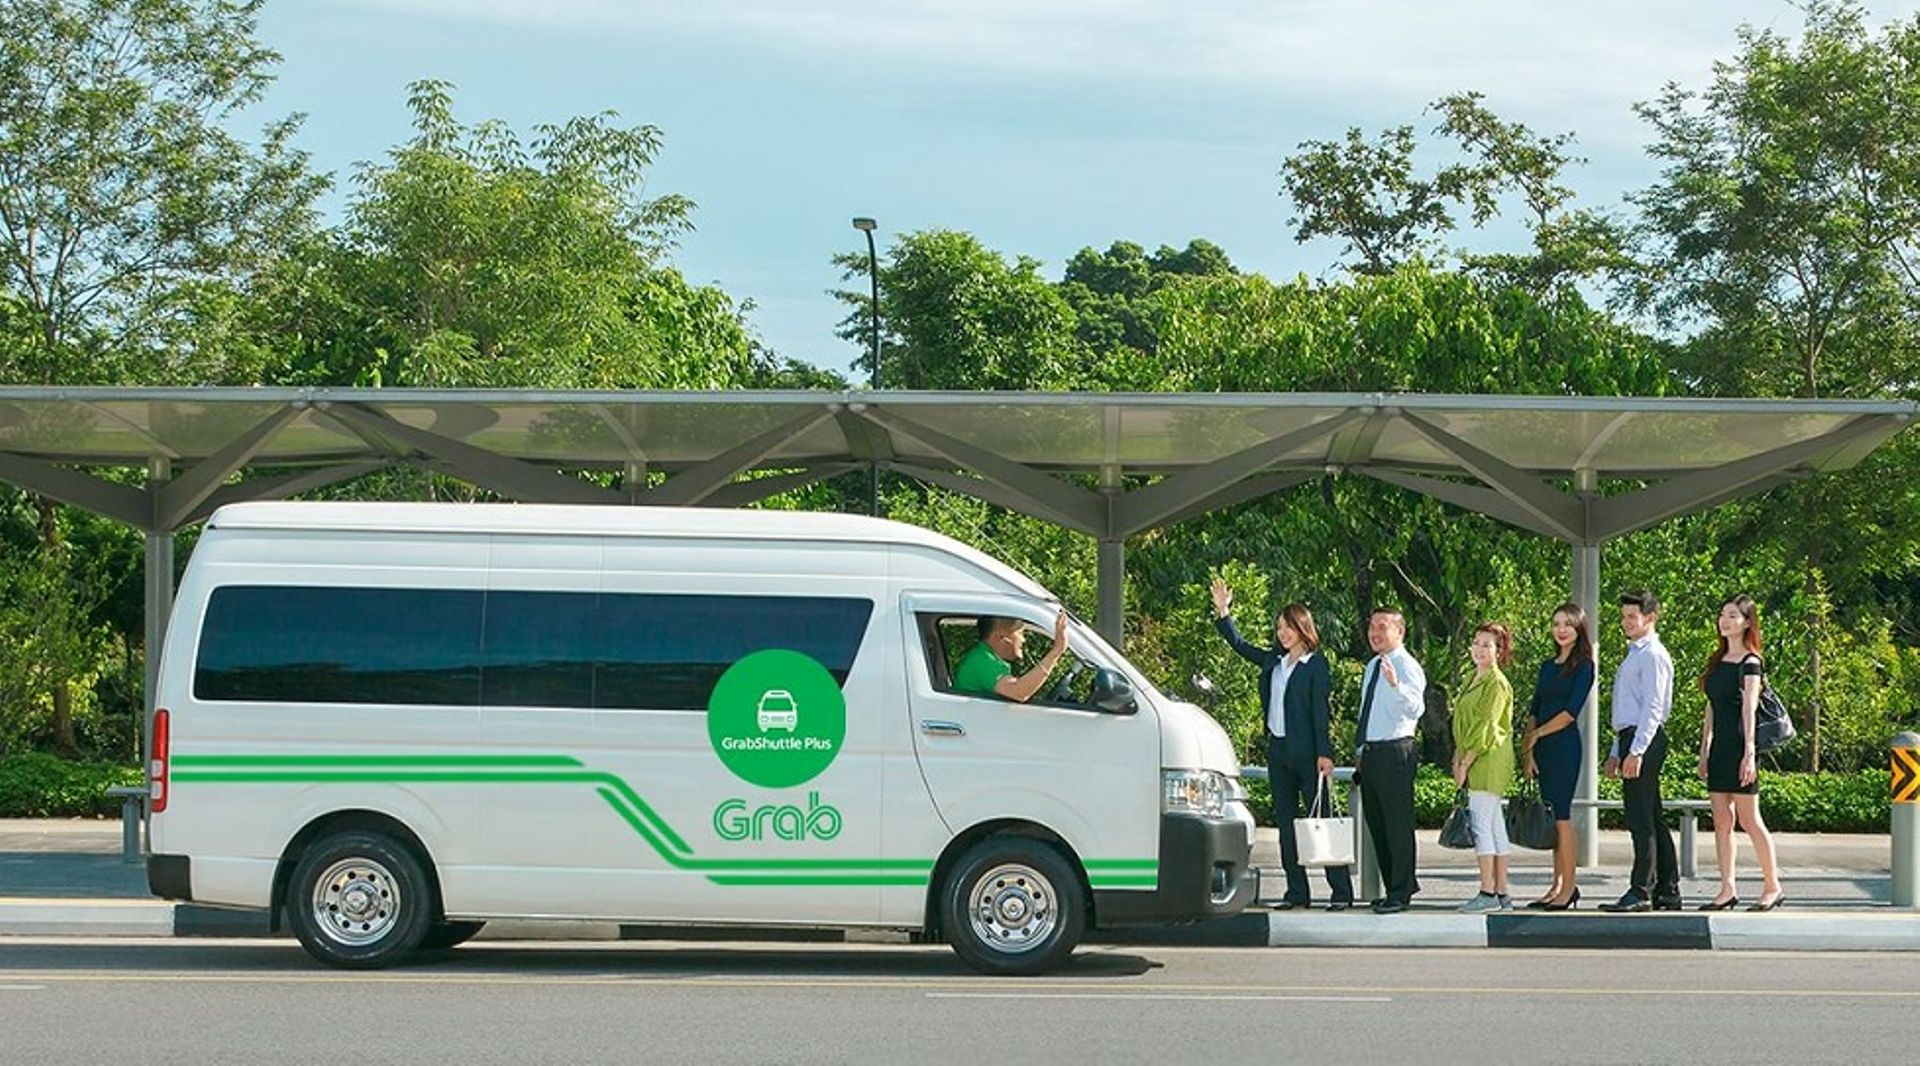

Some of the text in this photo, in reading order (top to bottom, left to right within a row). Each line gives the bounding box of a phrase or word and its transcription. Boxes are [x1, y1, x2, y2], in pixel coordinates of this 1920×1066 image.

[721, 737, 832, 750] GrabShuttle Plus
[713, 791, 842, 841] Grab
